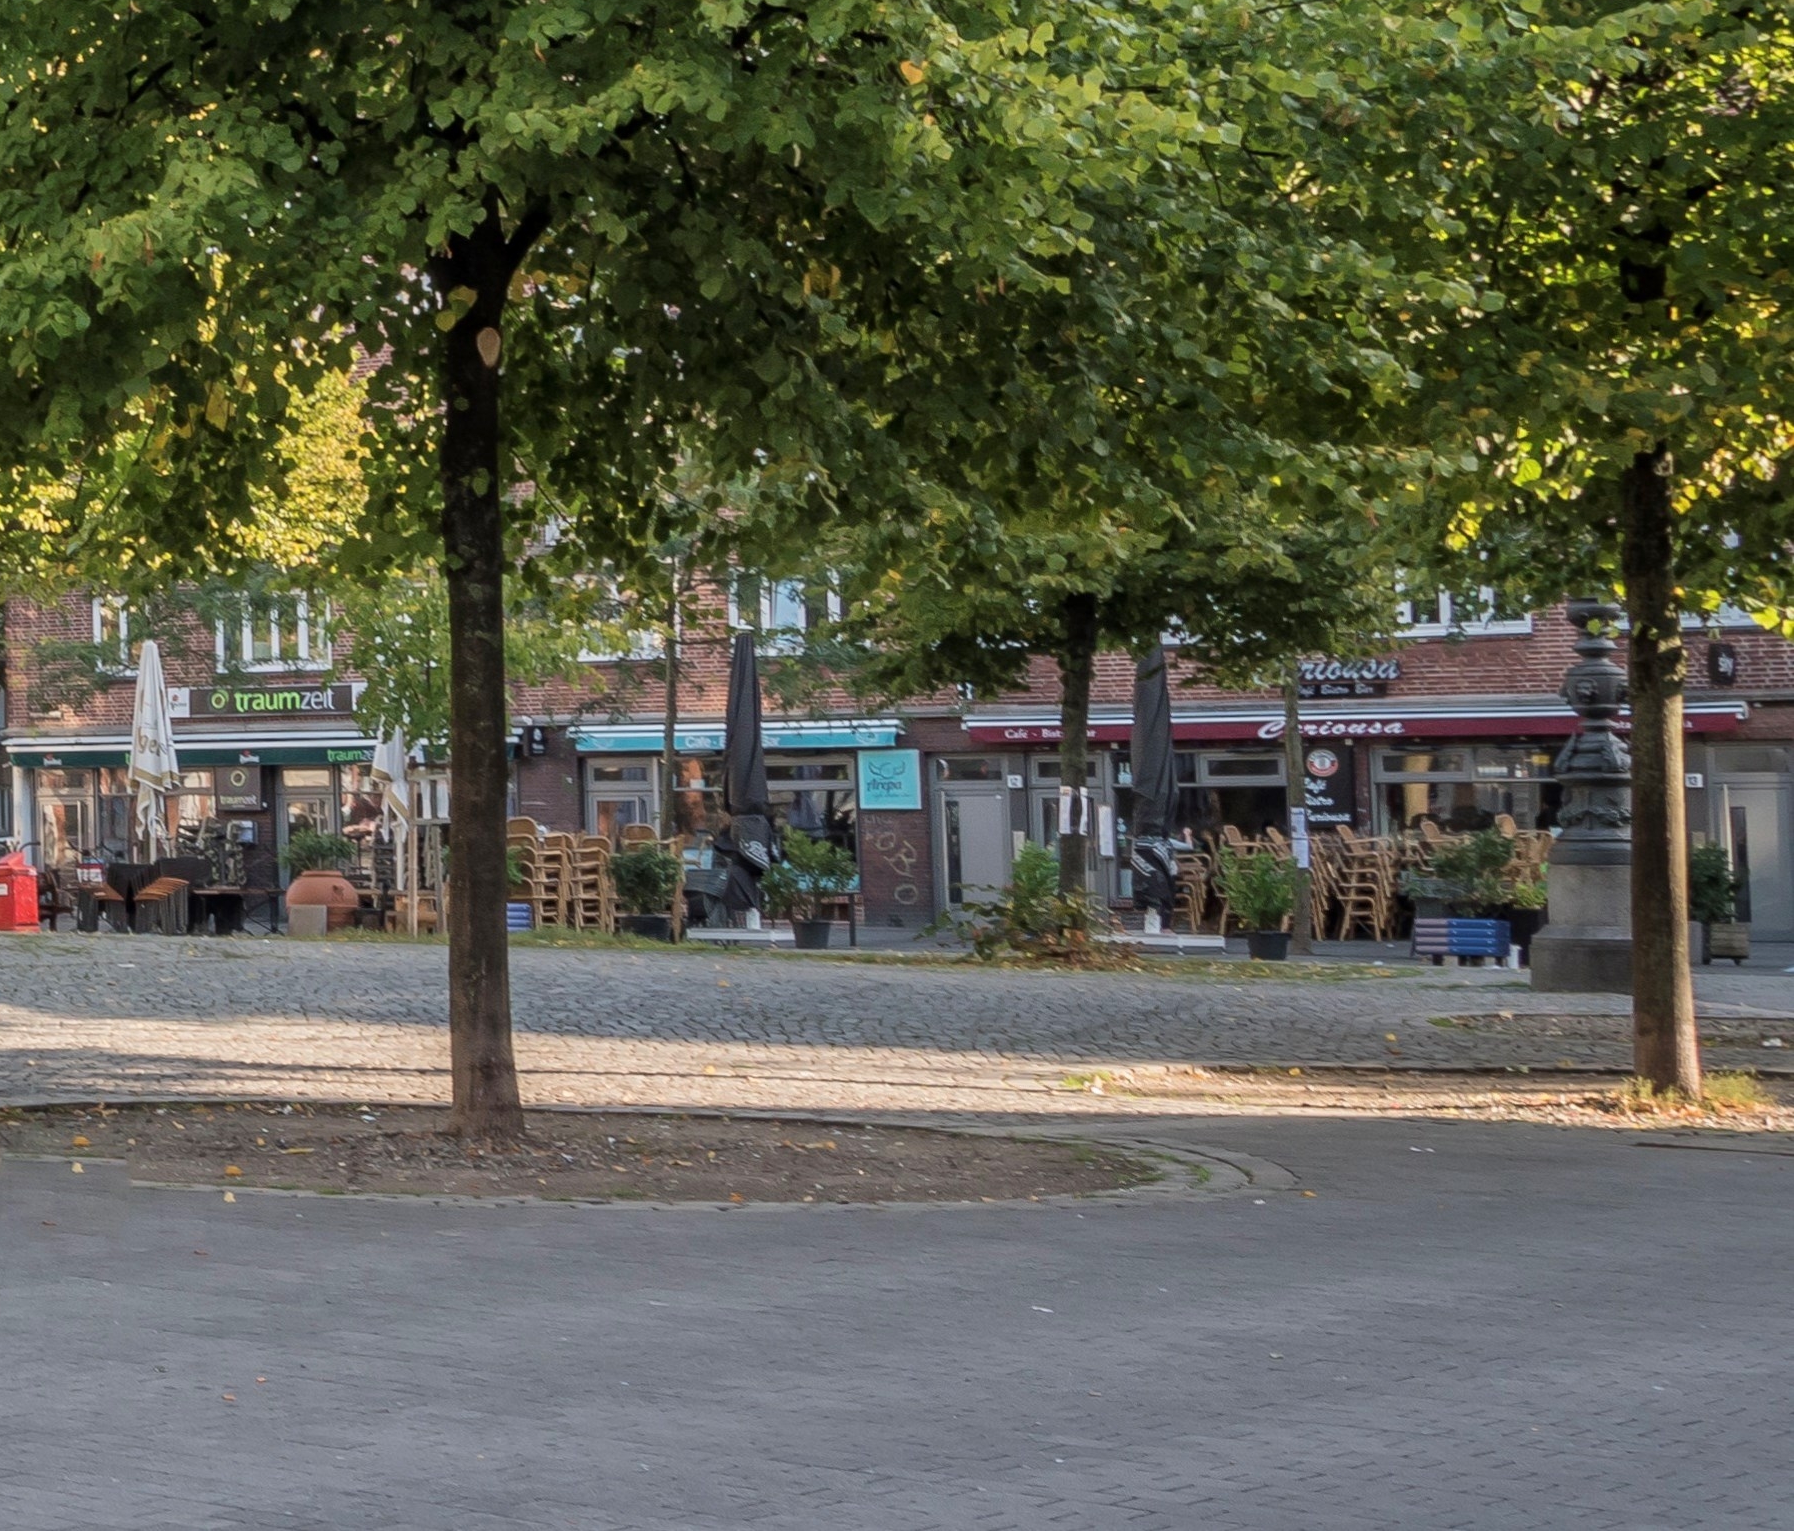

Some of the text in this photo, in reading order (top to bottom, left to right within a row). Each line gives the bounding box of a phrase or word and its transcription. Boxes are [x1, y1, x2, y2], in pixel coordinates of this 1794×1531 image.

[234, 688, 336, 713] traumzeit
[1041, 728, 1064, 739] Bist
[1257, 720, 1405, 740] Criousa
[327, 749, 374, 763] traumze
